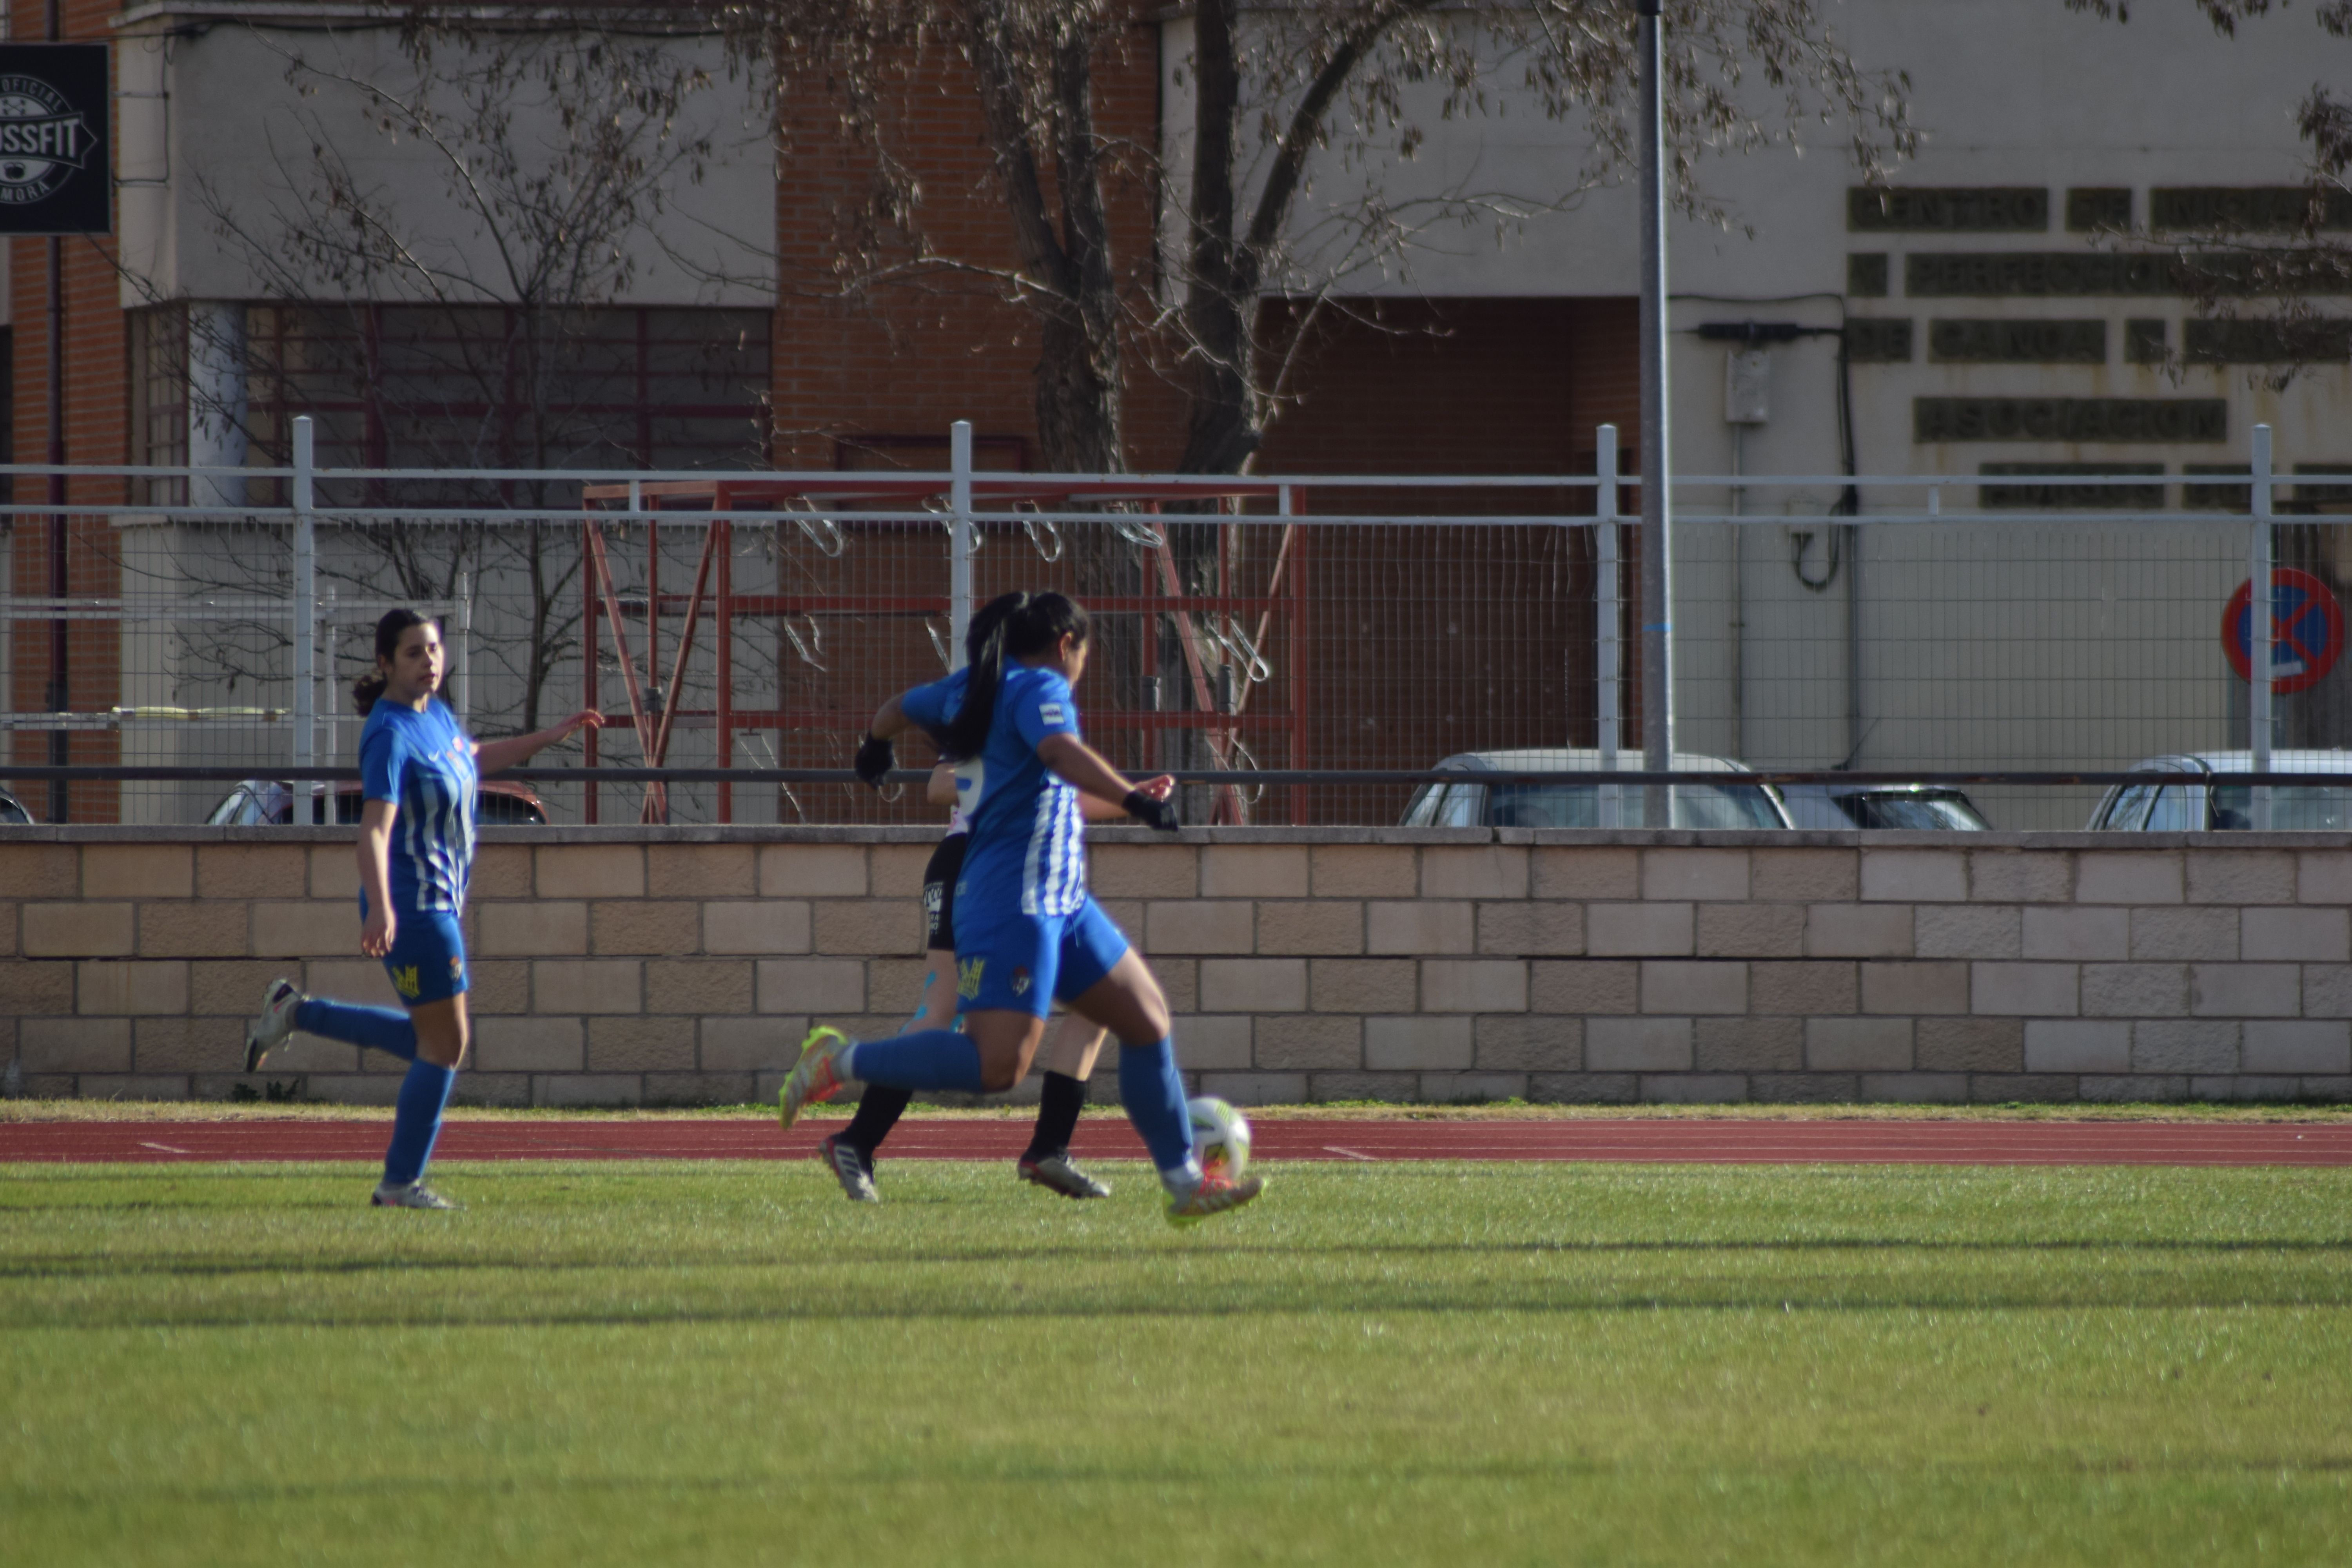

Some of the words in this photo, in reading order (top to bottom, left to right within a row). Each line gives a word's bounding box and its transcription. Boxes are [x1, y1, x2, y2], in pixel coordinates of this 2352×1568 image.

[2, 78, 61, 112] OFICIAL
[1851, 190, 2045, 229] CENTRO
[1933, 321, 2104, 361] CANOA
[1917, 400, 2224, 440] ASOCIACION
